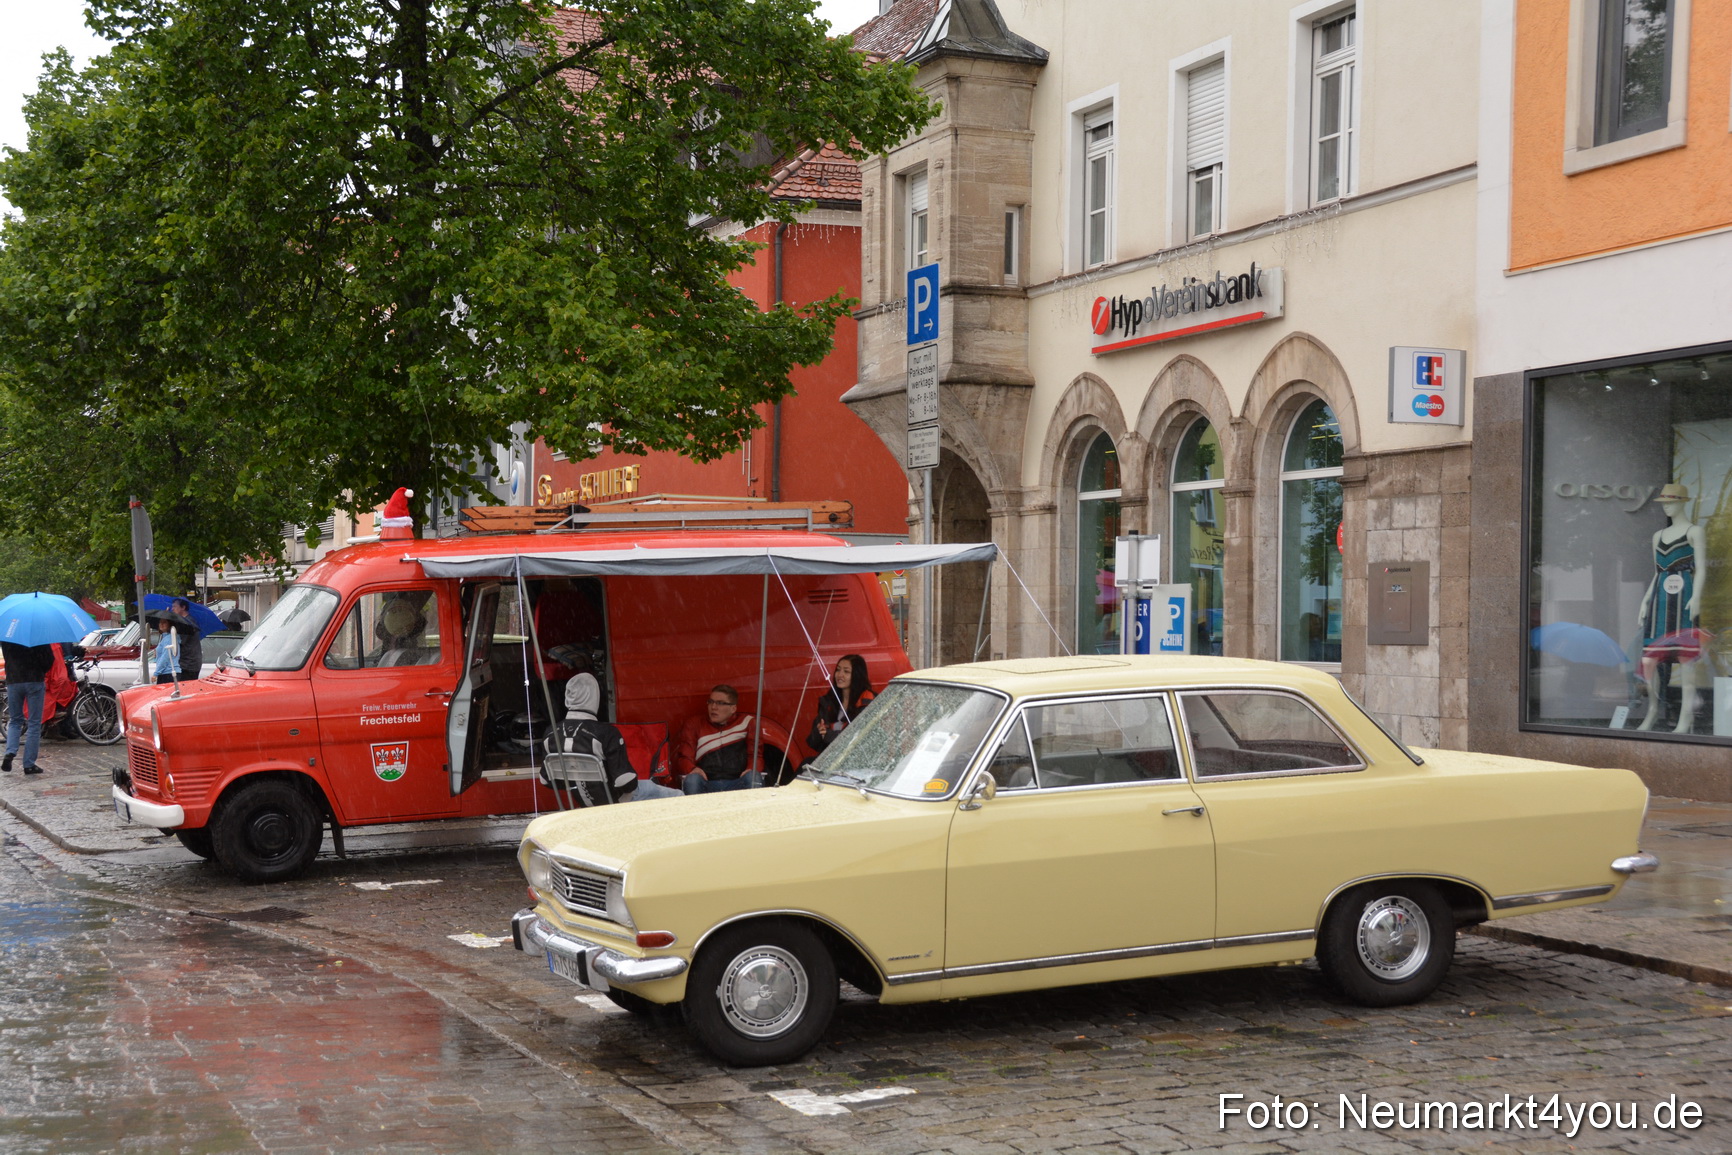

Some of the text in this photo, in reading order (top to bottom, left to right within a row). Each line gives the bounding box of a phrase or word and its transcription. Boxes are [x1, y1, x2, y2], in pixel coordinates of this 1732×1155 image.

[914, 276, 932, 334] P
[1111, 261, 1262, 338] HypoVereinsbank
[909, 363, 935, 378] Parkschein
[1414, 402, 1442, 410] Maestro
[1553, 483, 1656, 513] orsay
[362, 701, 417, 712] Freiw. Feuerwehr
[360, 713, 421, 726] Frechetsfeld
